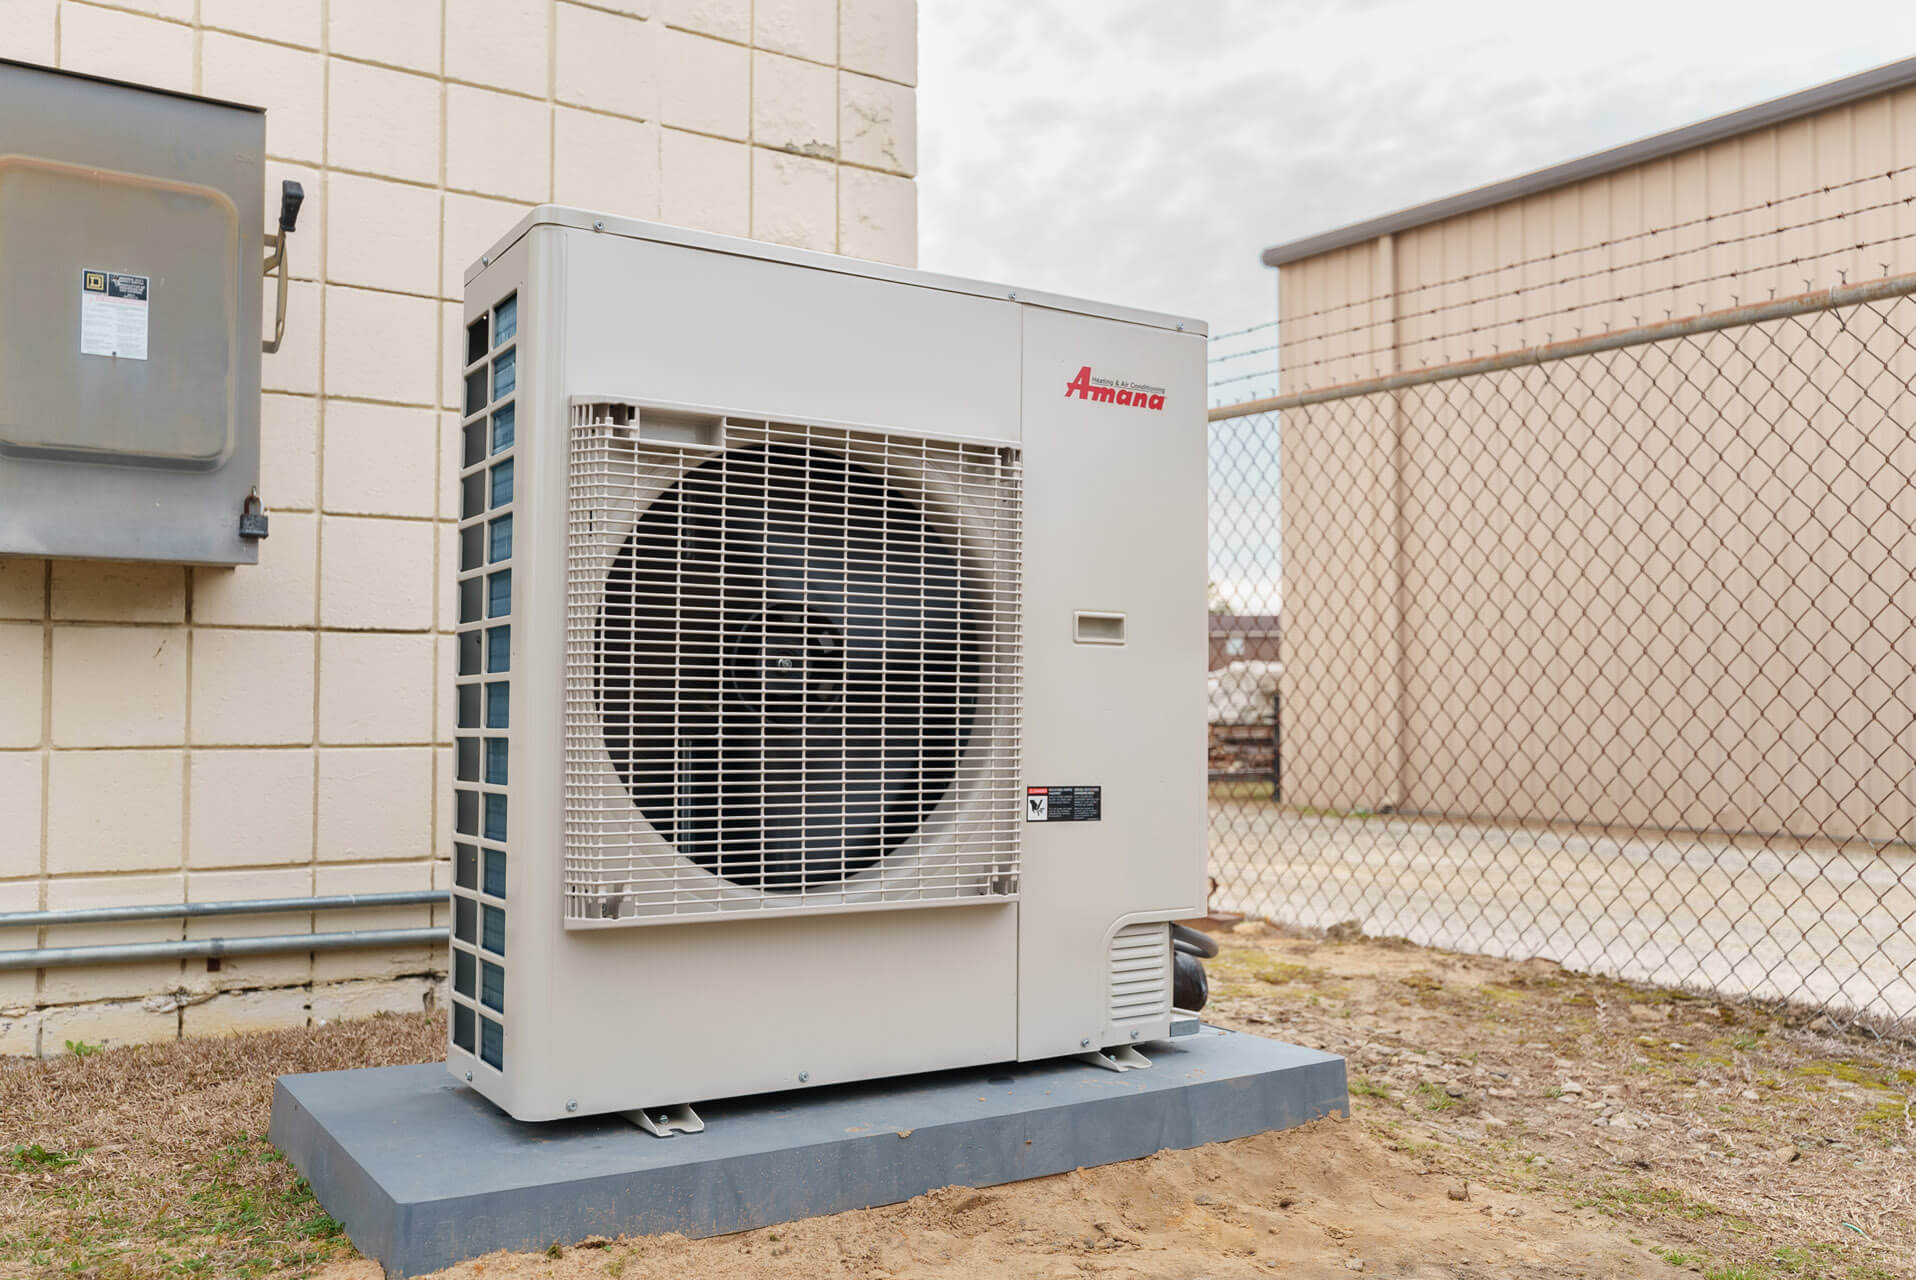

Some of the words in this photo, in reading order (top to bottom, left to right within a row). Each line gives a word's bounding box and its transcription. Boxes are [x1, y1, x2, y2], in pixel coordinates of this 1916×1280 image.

[1065, 366, 1165, 411] Amana
[1092, 377, 1114, 387] Heating
[1121, 380, 1129, 388] Air
